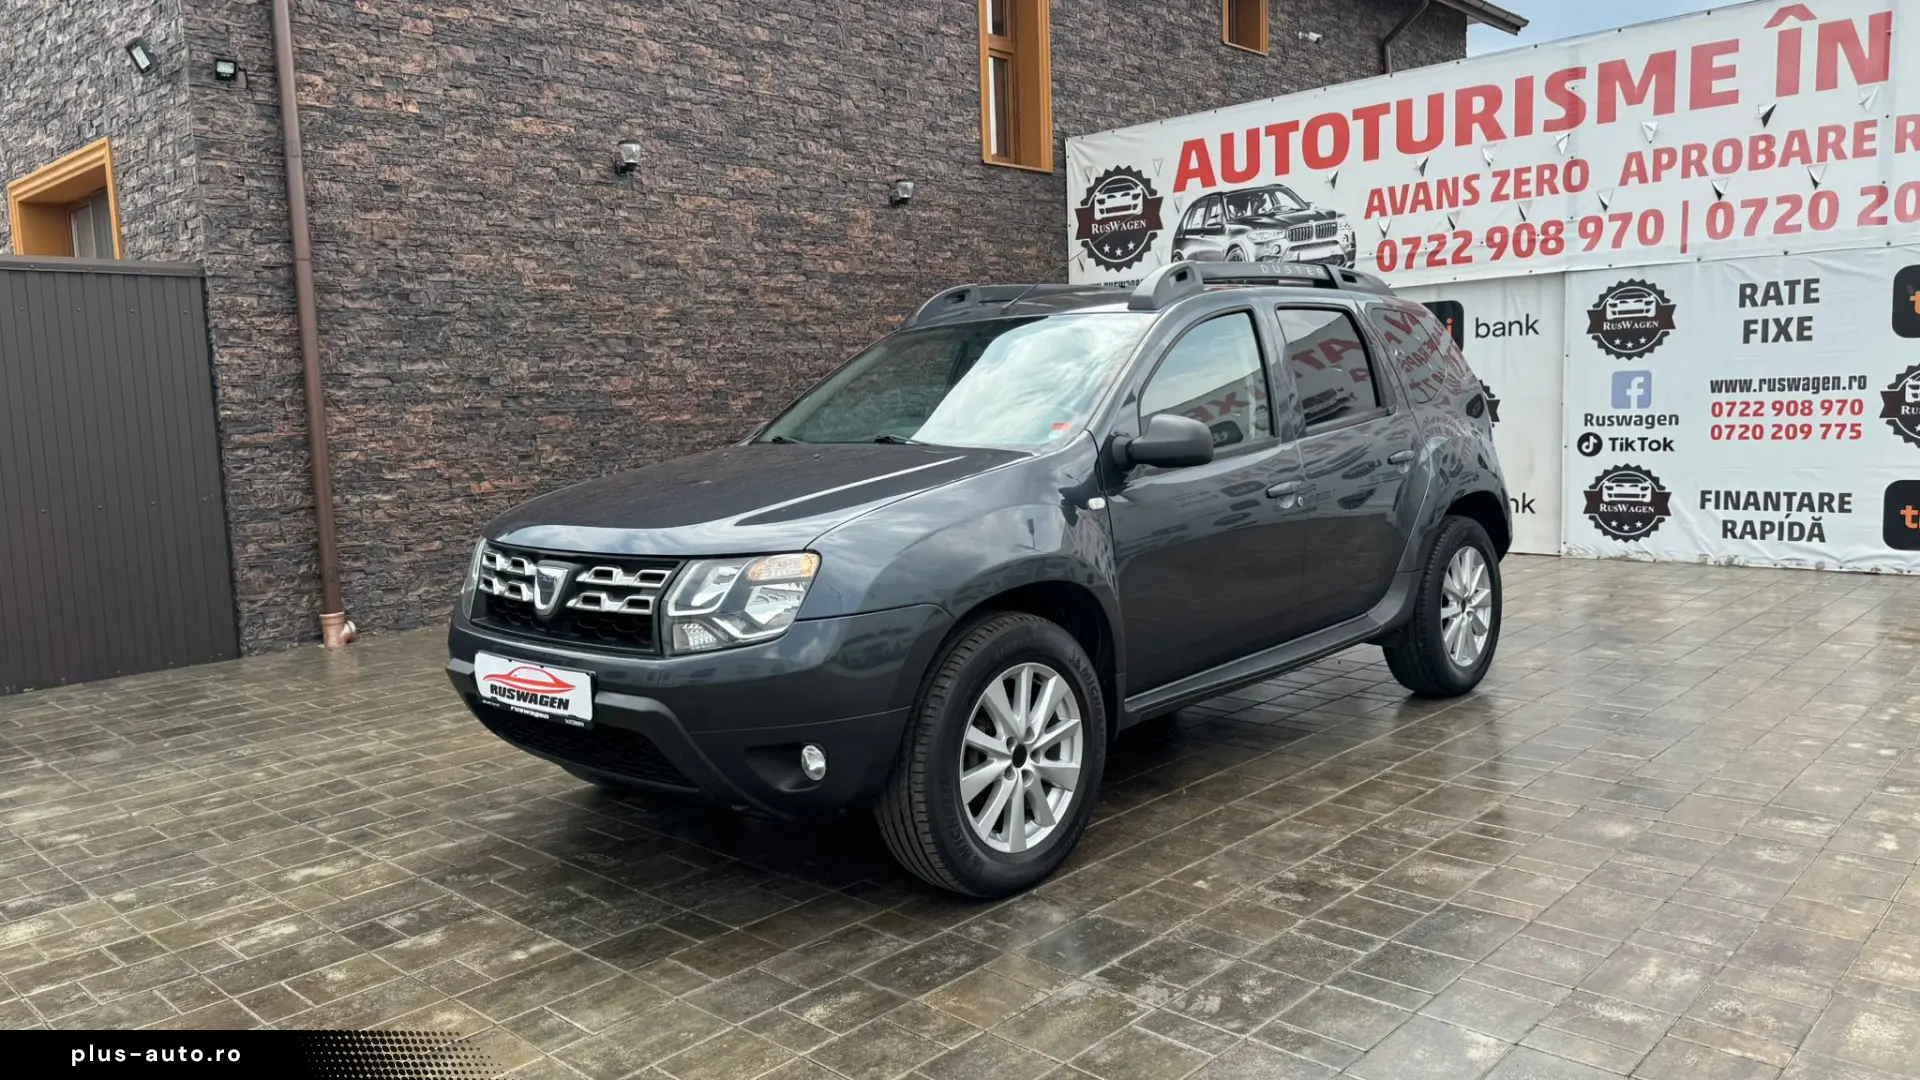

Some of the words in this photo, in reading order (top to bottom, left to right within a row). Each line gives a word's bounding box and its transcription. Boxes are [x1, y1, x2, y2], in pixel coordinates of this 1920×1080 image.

[1173, 38, 1740, 193] AUTOTURISME
[1763, 4, 1893, 98] ÎN
[1364, 173, 1481, 220] AVANS
[1490, 158, 1590, 203] ZERO
[1618, 119, 1879, 187] APROBARE
[1375, 229, 1473, 273] 0722
[1485, 219, 1565, 262] 908
[1577, 208, 1665, 252] 970
[1705, 189, 1840, 241] 0720
[1260, 264, 1326, 277] DUSTER
[1738, 277, 1821, 309] RATE
[1475, 313, 1540, 339] bank
[1742, 315, 1814, 344] FIXE
[1710, 374, 1868, 395] www.ruswagen.ro
[1583, 413, 1680, 429] Ruswagen
[1710, 401, 1765, 418] 0722
[1771, 400, 1814, 417] 908
[1819, 398, 1864, 416] 970
[1608, 436, 1676, 453] TikTok
[1710, 424, 1765, 441] 0720
[1770, 423, 1813, 440] 209
[1819, 423, 1862, 440] 775
[1721, 516, 1827, 543] RAPIDĂ
[490, 684, 571, 711] RUSWAGEN
